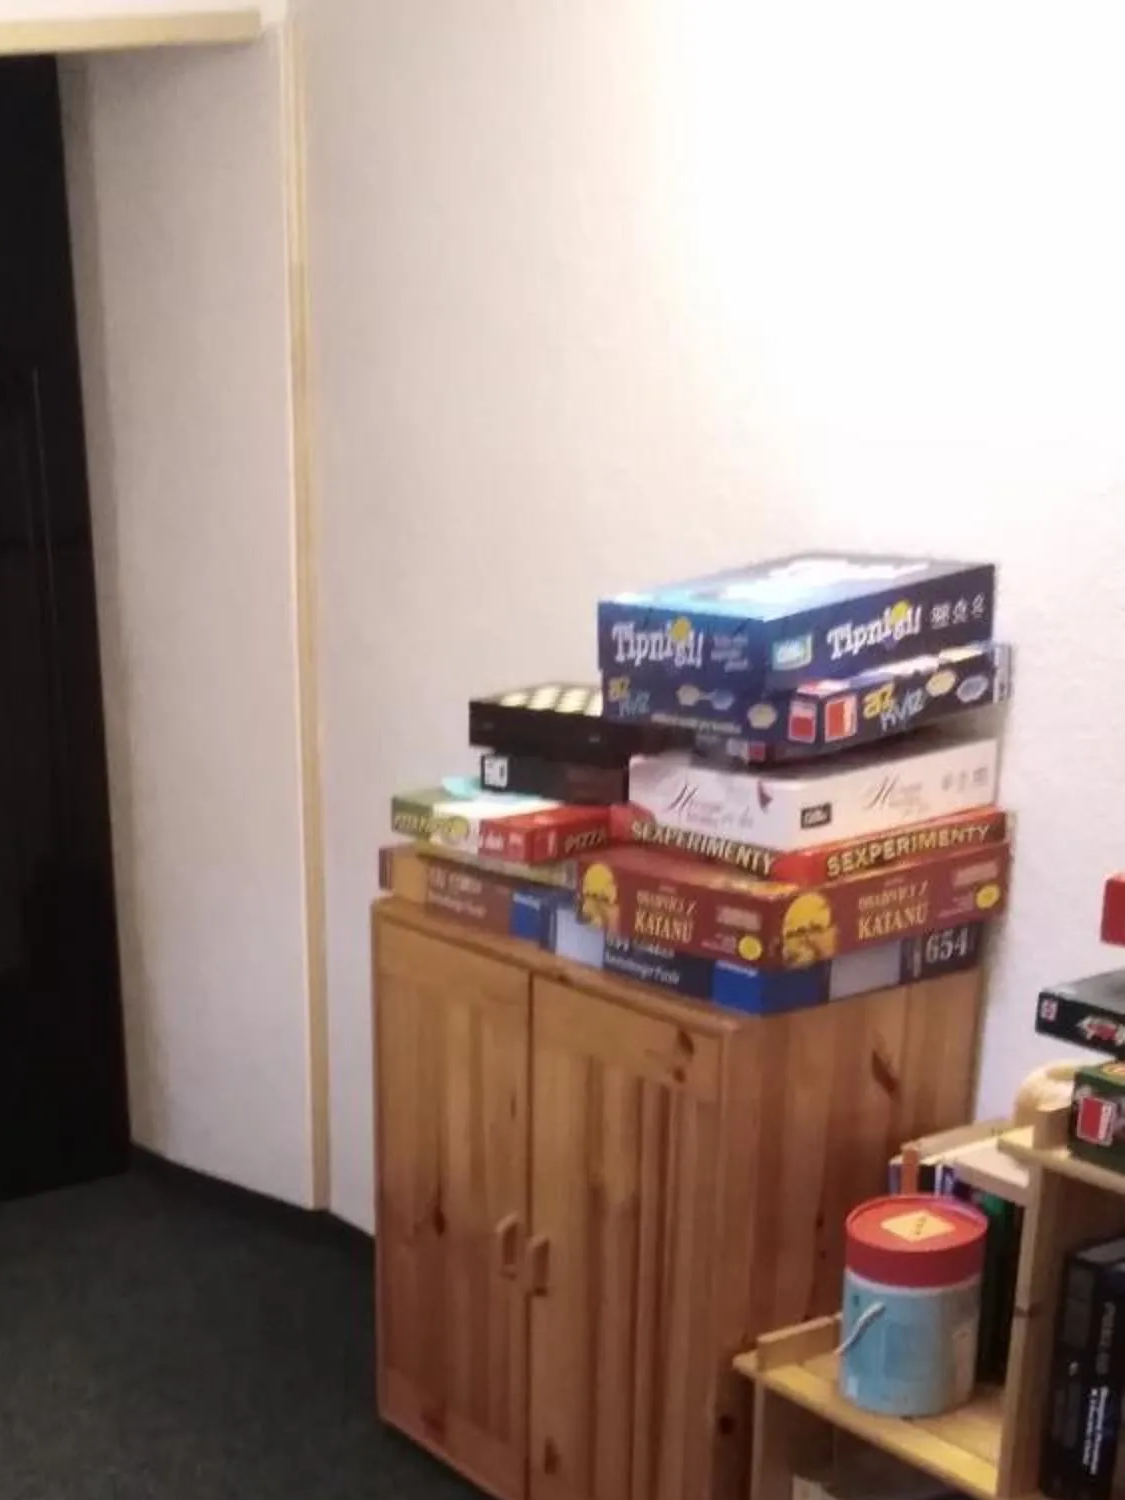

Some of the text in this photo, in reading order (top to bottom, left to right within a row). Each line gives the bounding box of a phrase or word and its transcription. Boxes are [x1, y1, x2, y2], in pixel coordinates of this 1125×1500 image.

[631, 820, 776, 876] SEXPERIMENTY
[826, 823, 990, 877] SEXPERIMENTY
[926, 927, 969, 964] 654
